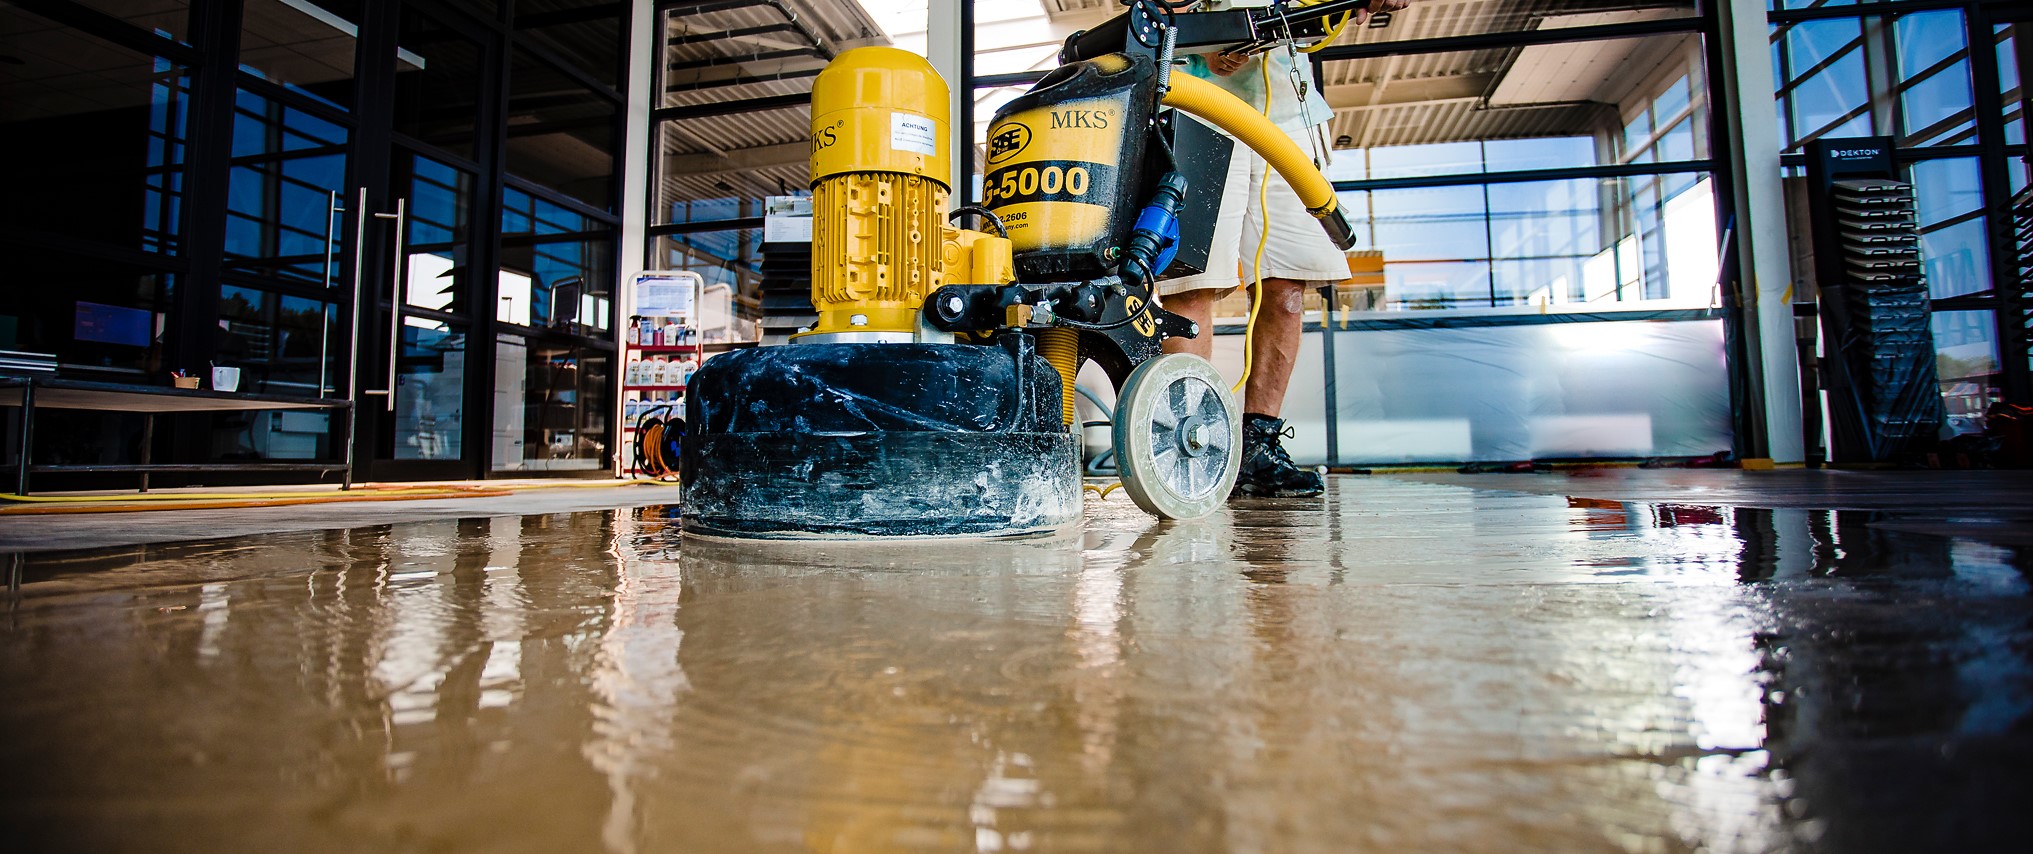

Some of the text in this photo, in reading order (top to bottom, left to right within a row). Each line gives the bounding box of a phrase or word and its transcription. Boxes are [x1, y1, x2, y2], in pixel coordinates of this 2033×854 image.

[902, 122, 928, 132] ACHTUNG
[1840, 149, 1879, 157] DEKTON
[998, 211, 1027, 223] 2.2606
